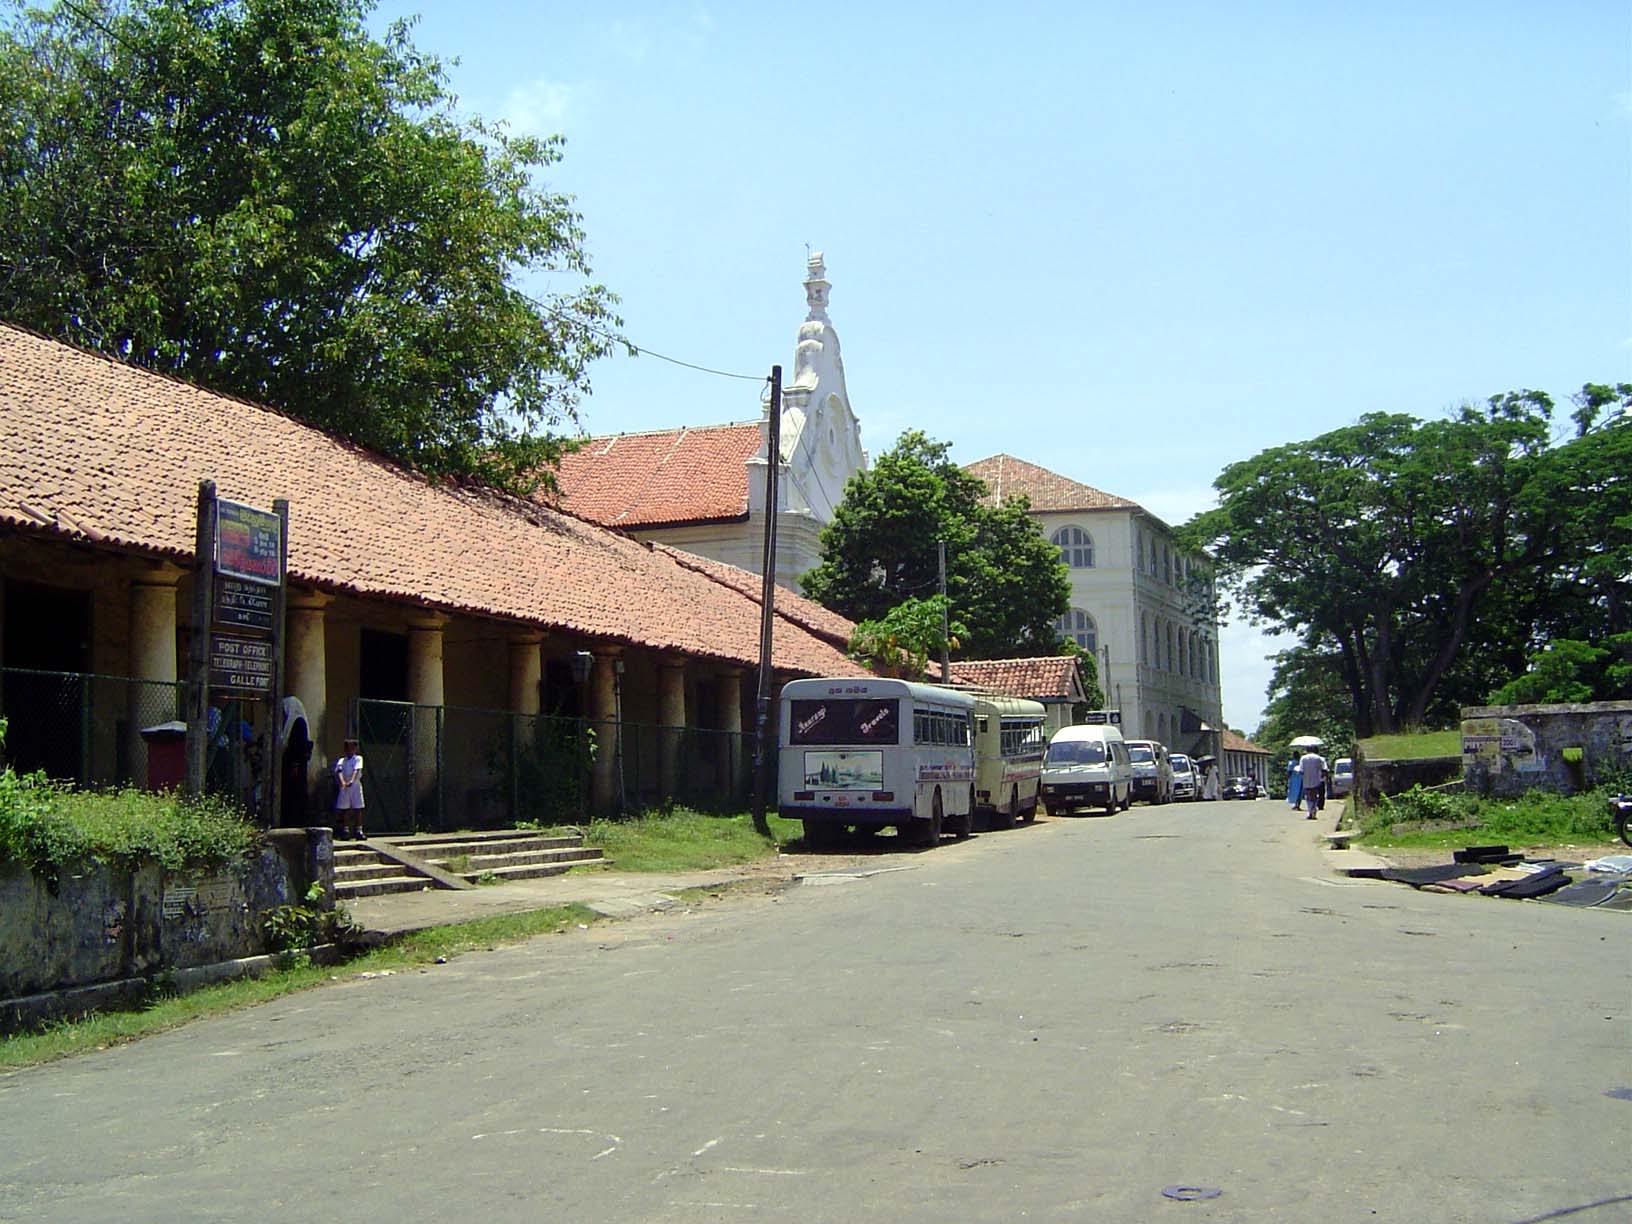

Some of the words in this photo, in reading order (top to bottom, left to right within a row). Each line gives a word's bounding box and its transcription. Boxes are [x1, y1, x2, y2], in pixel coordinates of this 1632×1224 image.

[218, 642, 240, 654] POST
[242, 644, 267, 657] OFFICE
[230, 674, 255, 686] GALLE
[255, 676, 270, 687] FORT
[860, 708, 889, 734] Travels
